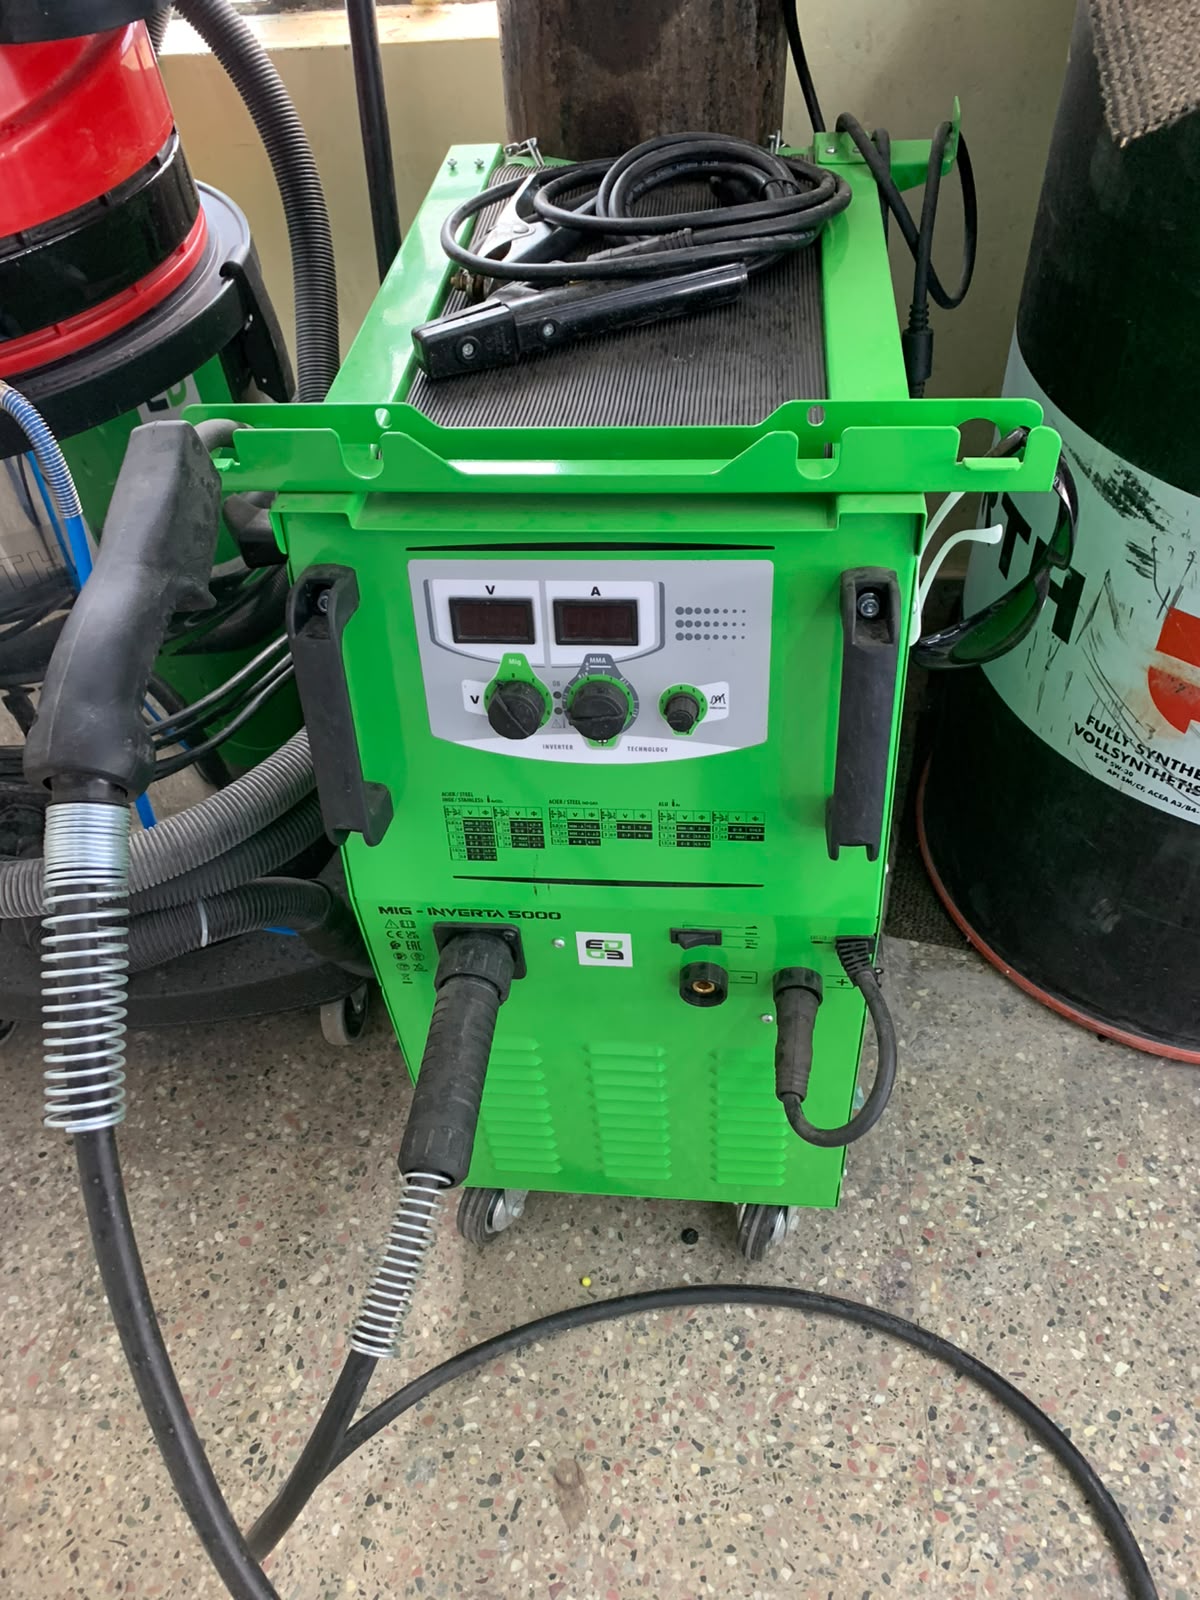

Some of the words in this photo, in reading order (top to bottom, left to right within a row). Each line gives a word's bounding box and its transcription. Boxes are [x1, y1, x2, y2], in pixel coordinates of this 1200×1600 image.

[485, 585, 495, 595] V
[591, 586, 601, 597] A
[470, 695, 480, 705] V
[1086, 714, 1132, 747] FULLY
[1095, 752, 1108, 764] SAE
[1106, 768, 1120, 779] API
[1148, 789, 1169, 802] ACEA
[378, 906, 412, 915] MIG
[427, 907, 504, 918] INVERTA
[508, 910, 561, 920] 5000
